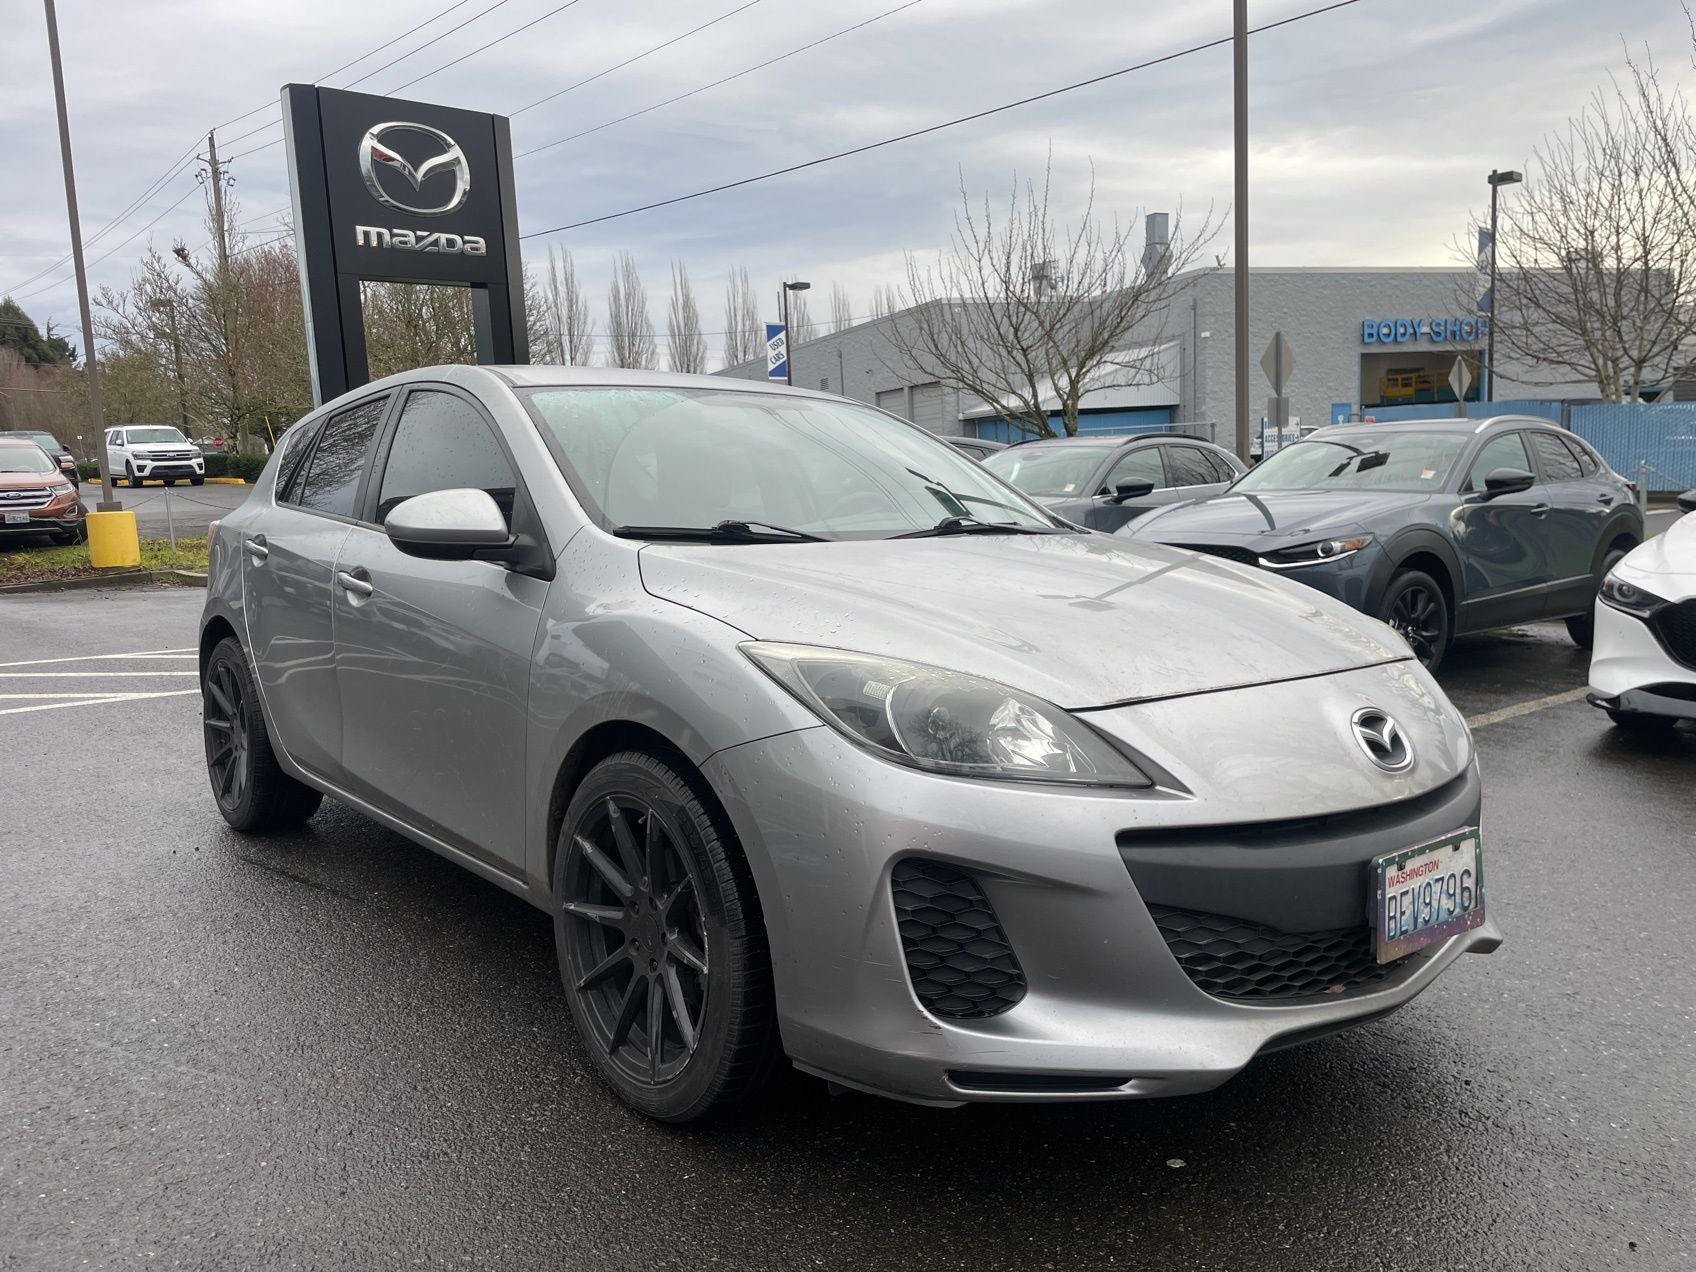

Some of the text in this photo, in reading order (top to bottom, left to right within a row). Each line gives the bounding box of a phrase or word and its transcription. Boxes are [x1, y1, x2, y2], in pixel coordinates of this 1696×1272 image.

[1362, 319, 1423, 344] BODY
[769, 337, 785, 351] USED
[770, 351, 785, 365] CARS
[1264, 433, 1296, 443] ACCESORIES
[1388, 859, 1440, 888] WASHINGTON
[1387, 868, 1472, 941] BEV9796
